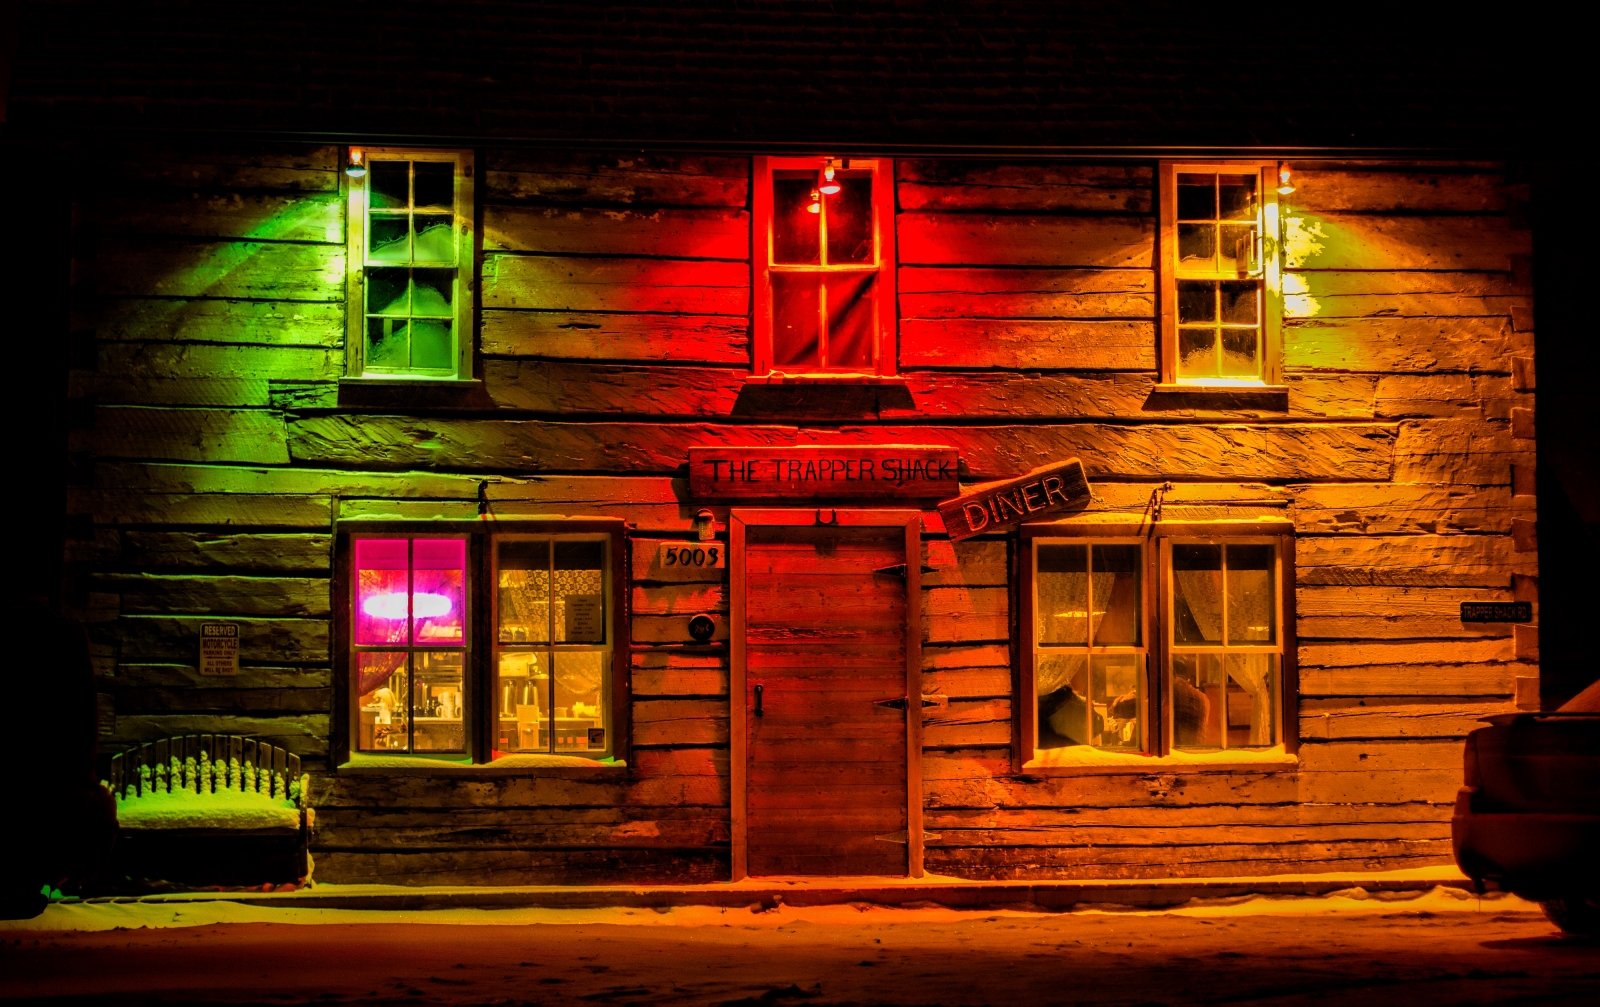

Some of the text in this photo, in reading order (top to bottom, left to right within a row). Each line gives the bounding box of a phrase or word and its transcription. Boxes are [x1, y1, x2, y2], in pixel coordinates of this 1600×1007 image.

[704, 458, 952, 483] THE TRAPPER SHACK
[962, 475, 1069, 532] DINER
[666, 546, 719, 566] 5003
[1463, 605, 1493, 619] TRAPPER
[1494, 605, 1516, 619] SHACK
[204, 625, 236, 636] RESERVED
[202, 638, 237, 649] MOTORCYCLE
